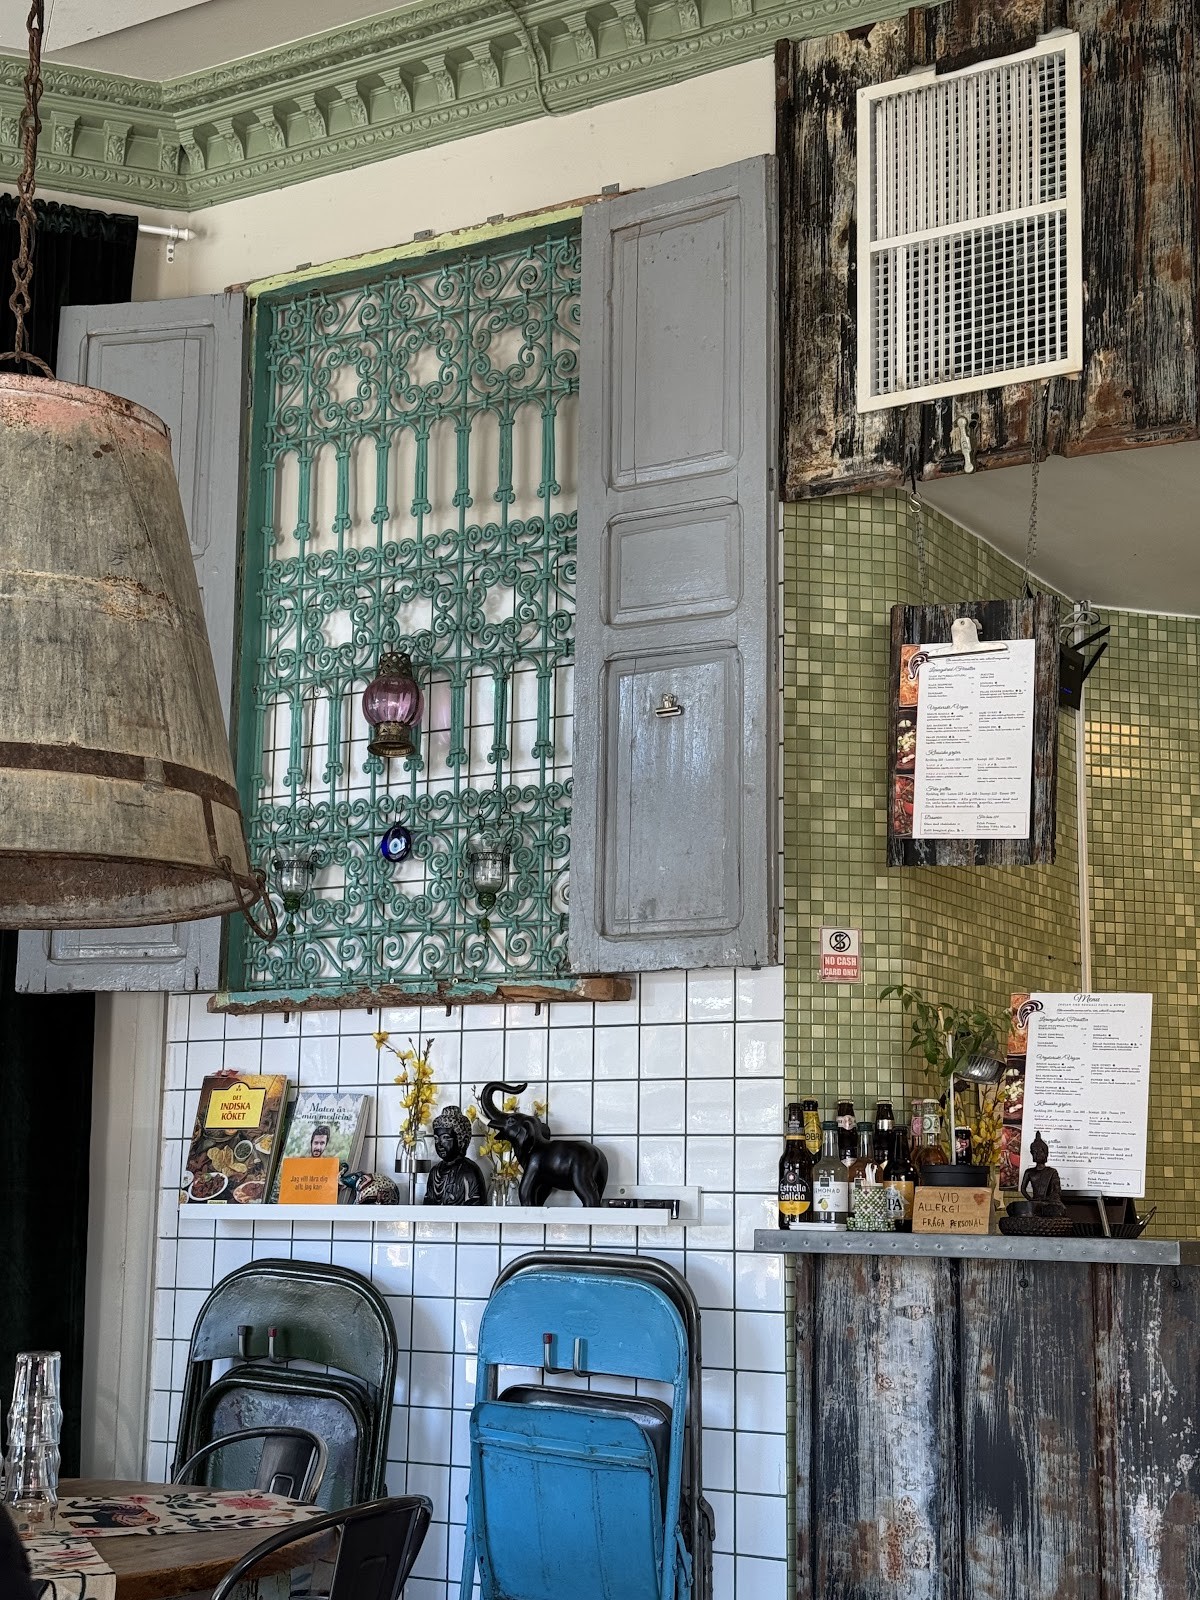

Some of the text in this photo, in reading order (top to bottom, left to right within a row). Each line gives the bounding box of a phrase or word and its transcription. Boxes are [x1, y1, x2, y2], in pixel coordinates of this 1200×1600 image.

[824, 956, 857, 966] NO CASH
[824, 967, 858, 977] CARD ONLY
[1073, 993, 1101, 1003] Menu
[220, 1102, 251, 1110] INDISKA
[221, 1110, 247, 1121] KÖKET
[779, 1183, 807, 1193] Estrella
[780, 1192, 806, 1201] Galicia
[938, 1191, 960, 1204] VID
[886, 1198, 903, 1211] PA
[917, 1201, 960, 1214] ALLERGI
[922, 1216, 985, 1229] FRÅGA PERSONAL
